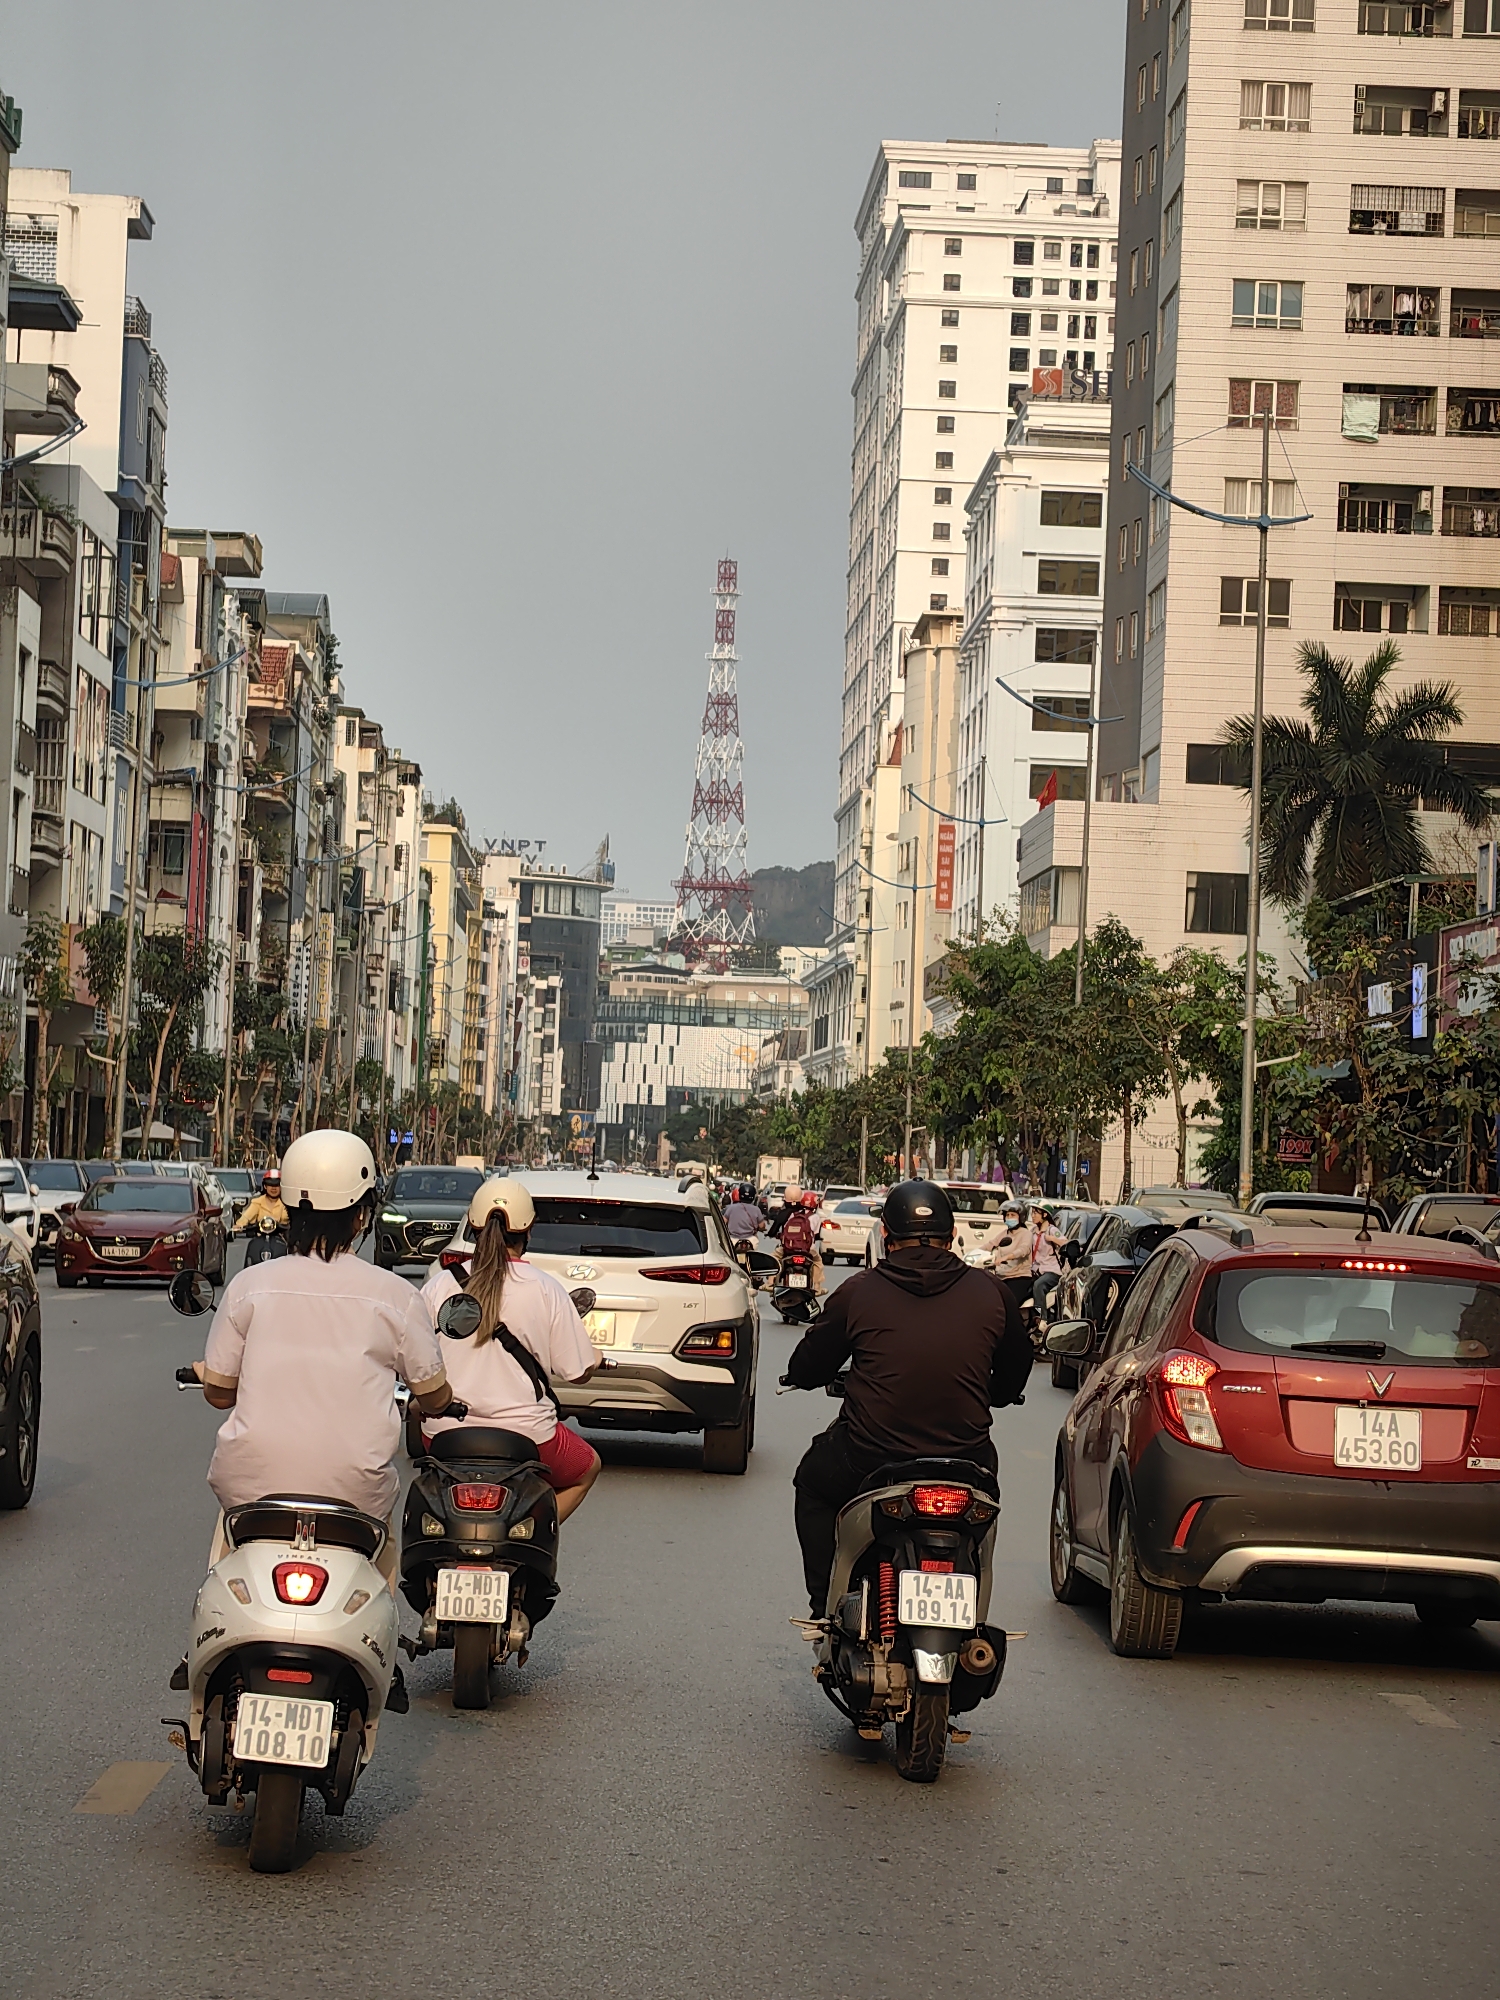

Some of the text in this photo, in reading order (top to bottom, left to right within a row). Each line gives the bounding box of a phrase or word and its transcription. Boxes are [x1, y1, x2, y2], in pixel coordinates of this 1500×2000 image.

[484, 838, 547, 852] VNPT
[1279, 1139, 1314, 1154] 199K
[1222, 1385, 1267, 1394] FADIL
[1359, 1411, 1400, 1438] 14A
[1338, 1437, 1418, 1466] 453.60
[277, 1554, 329, 1564] VINFAST
[912, 1575, 965, 1600] 14-AA
[442, 1595, 503, 1618] 100.36
[905, 1598, 972, 1625] 189.14
[243, 1728, 324, 1763] 108.10
